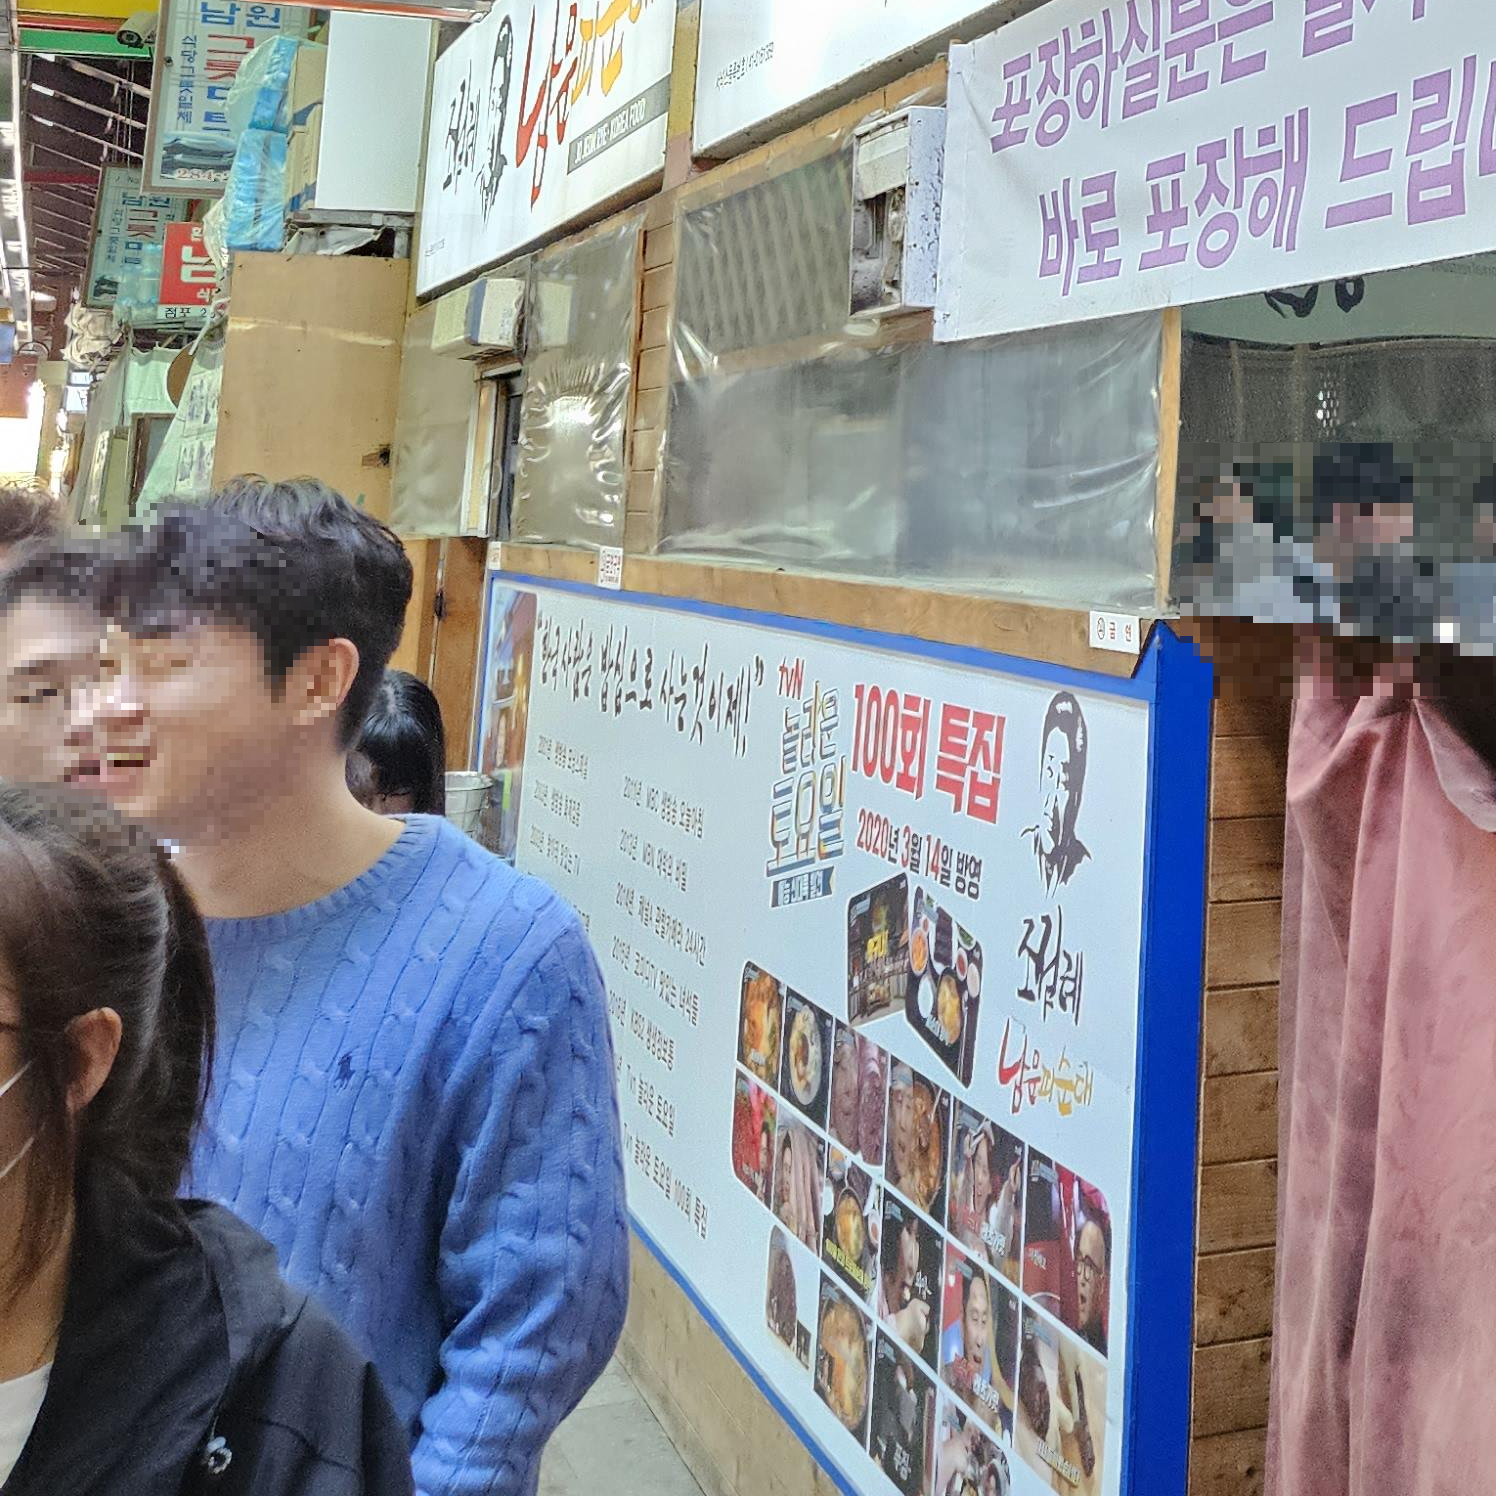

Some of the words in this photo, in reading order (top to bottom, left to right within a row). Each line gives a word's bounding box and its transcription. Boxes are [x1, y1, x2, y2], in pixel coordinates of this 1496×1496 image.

[200, 1, 281, 30] 남원
[1037, 167, 1121, 297] 바로
[1137, 105, 1311, 271] 포장해
[778, 655, 805, 701] tvN
[783, 679, 840, 774] 놀라운
[851, 682, 932, 800] 100회
[936, 702, 1007, 825] 특집
[765, 753, 846, 878] 토요일
[856, 807, 900, 865] 2020년
[900, 824, 924, 874] 3월
[926, 834, 954, 886] 14일
[955, 844, 982, 901] 방영
